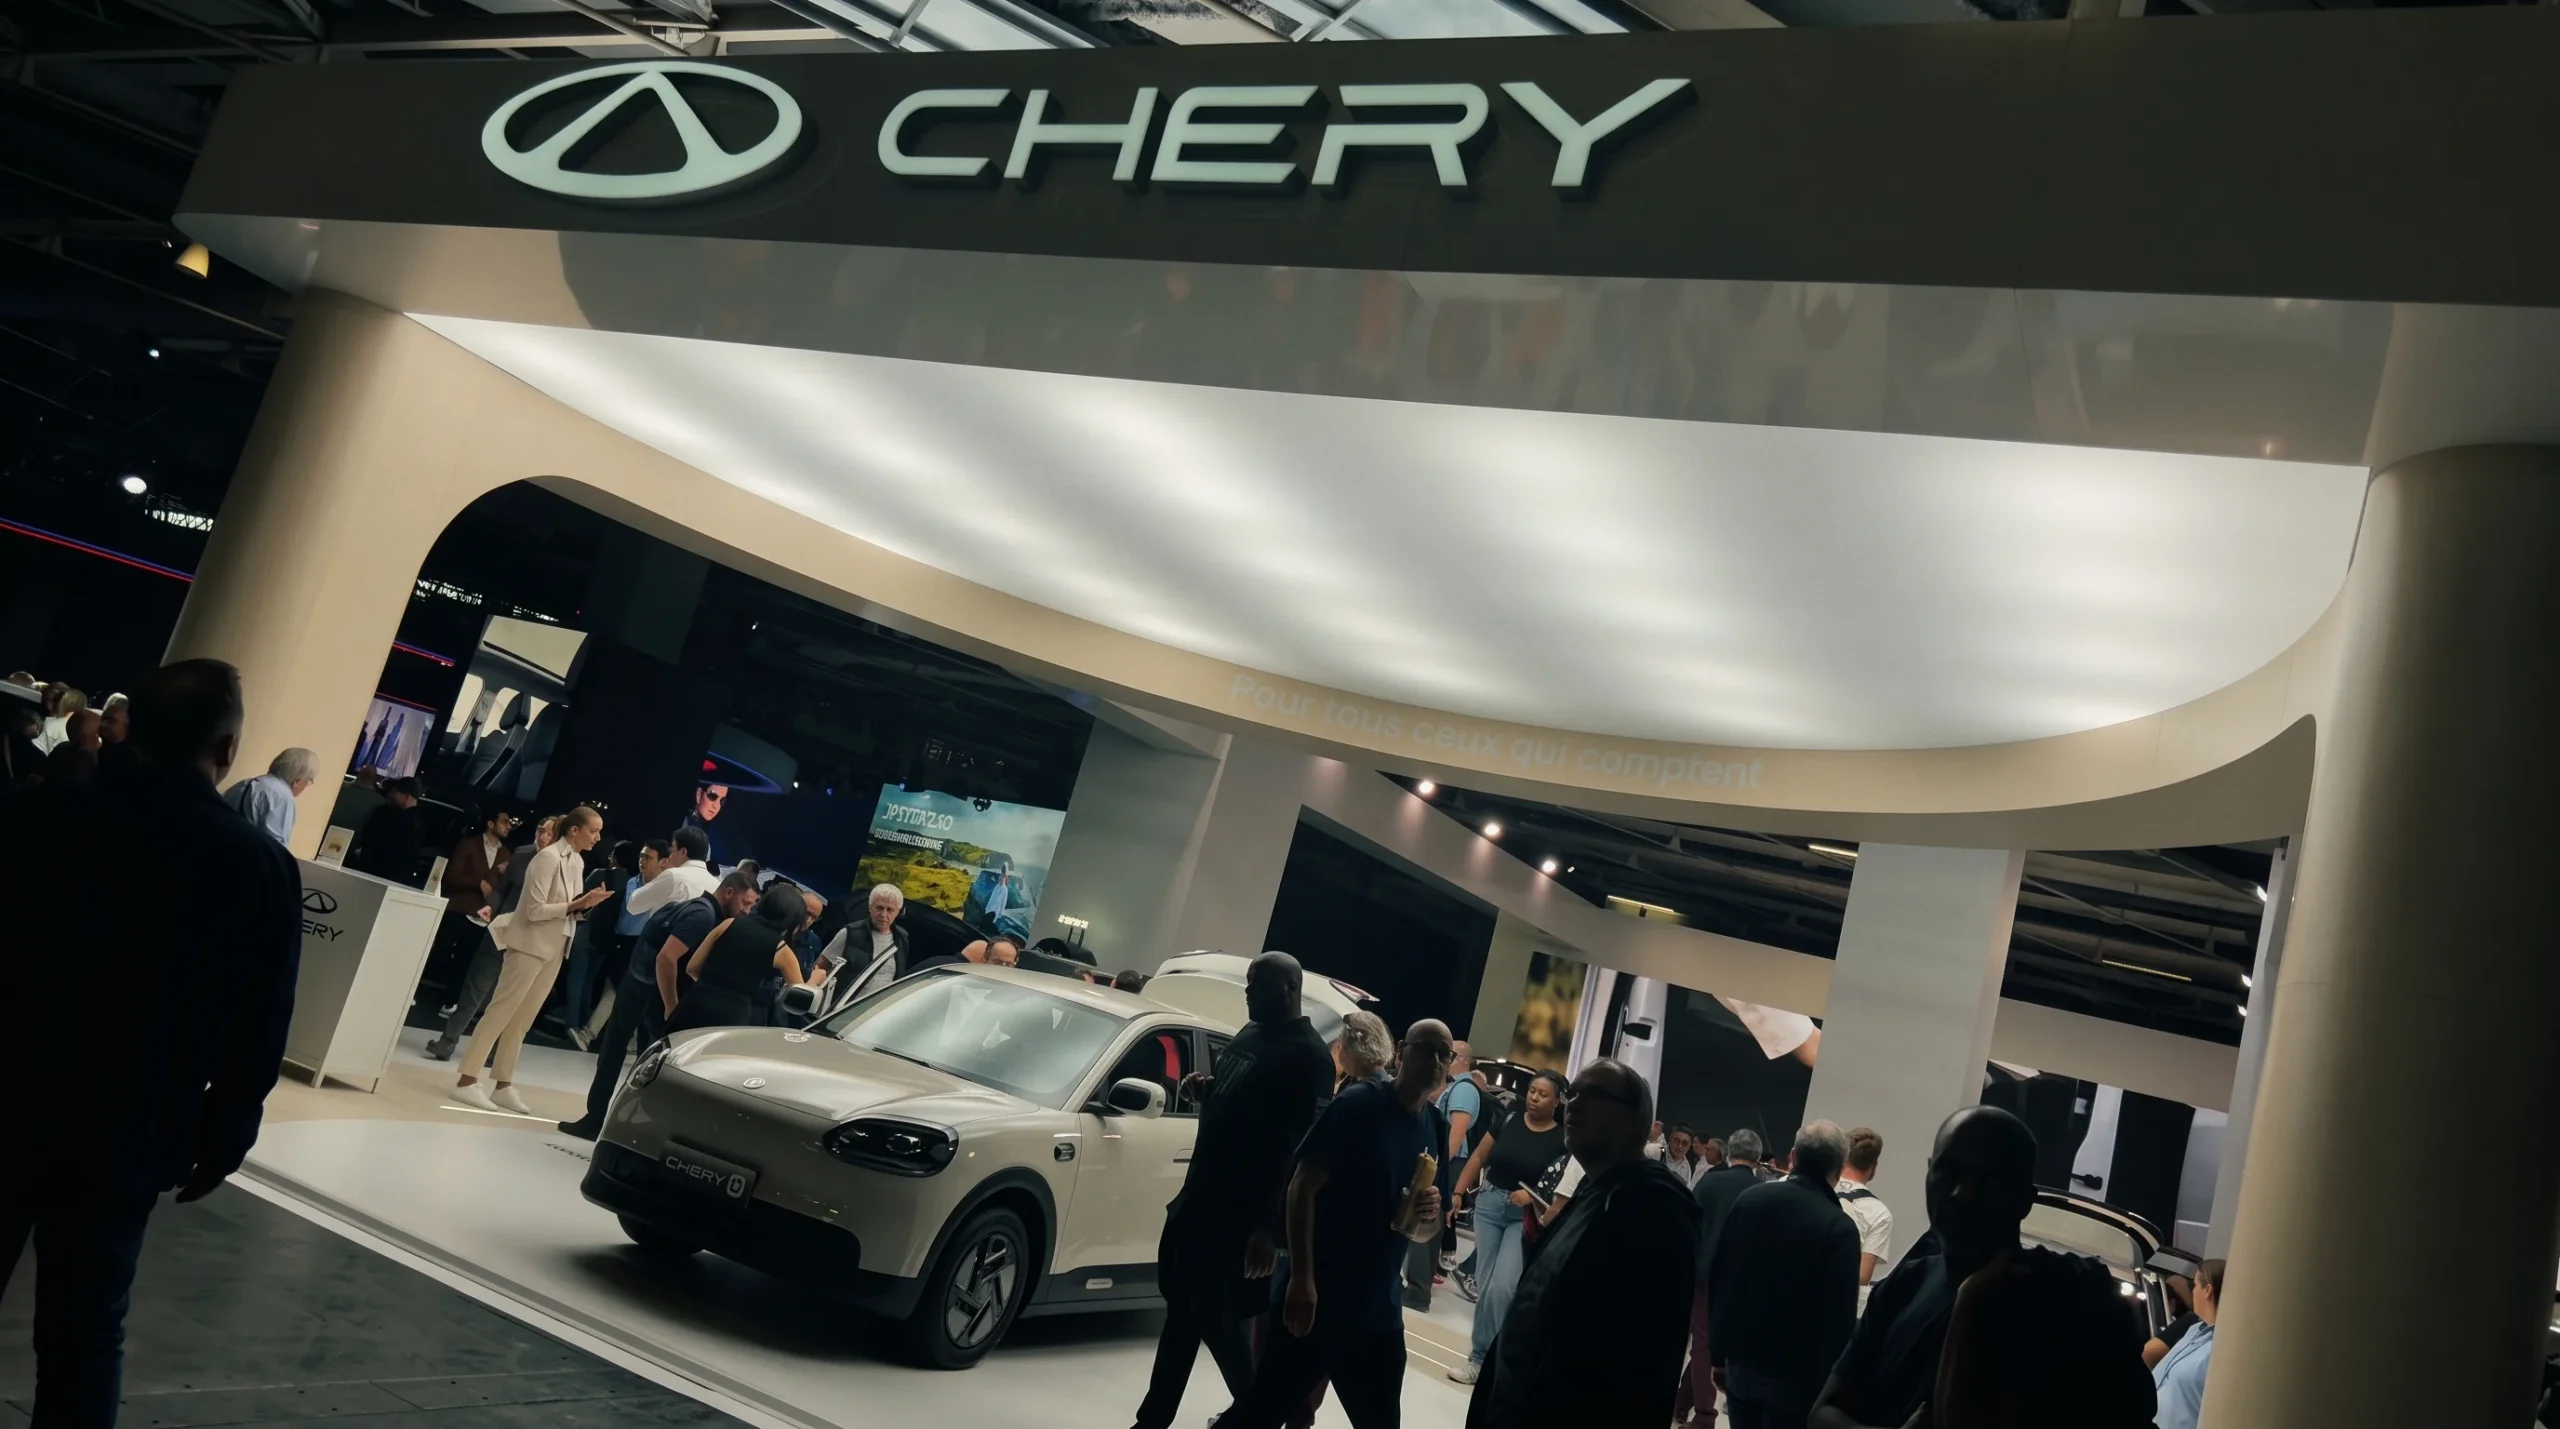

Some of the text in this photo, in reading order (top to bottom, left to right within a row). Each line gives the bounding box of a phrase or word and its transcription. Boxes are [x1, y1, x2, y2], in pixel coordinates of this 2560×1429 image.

[878, 78, 1692, 187] CHERY
[1230, 673, 1763, 789] Pour tous ceux qui comptent
[302, 919, 344, 941] ERY
[665, 1155, 726, 1186] CHERY
